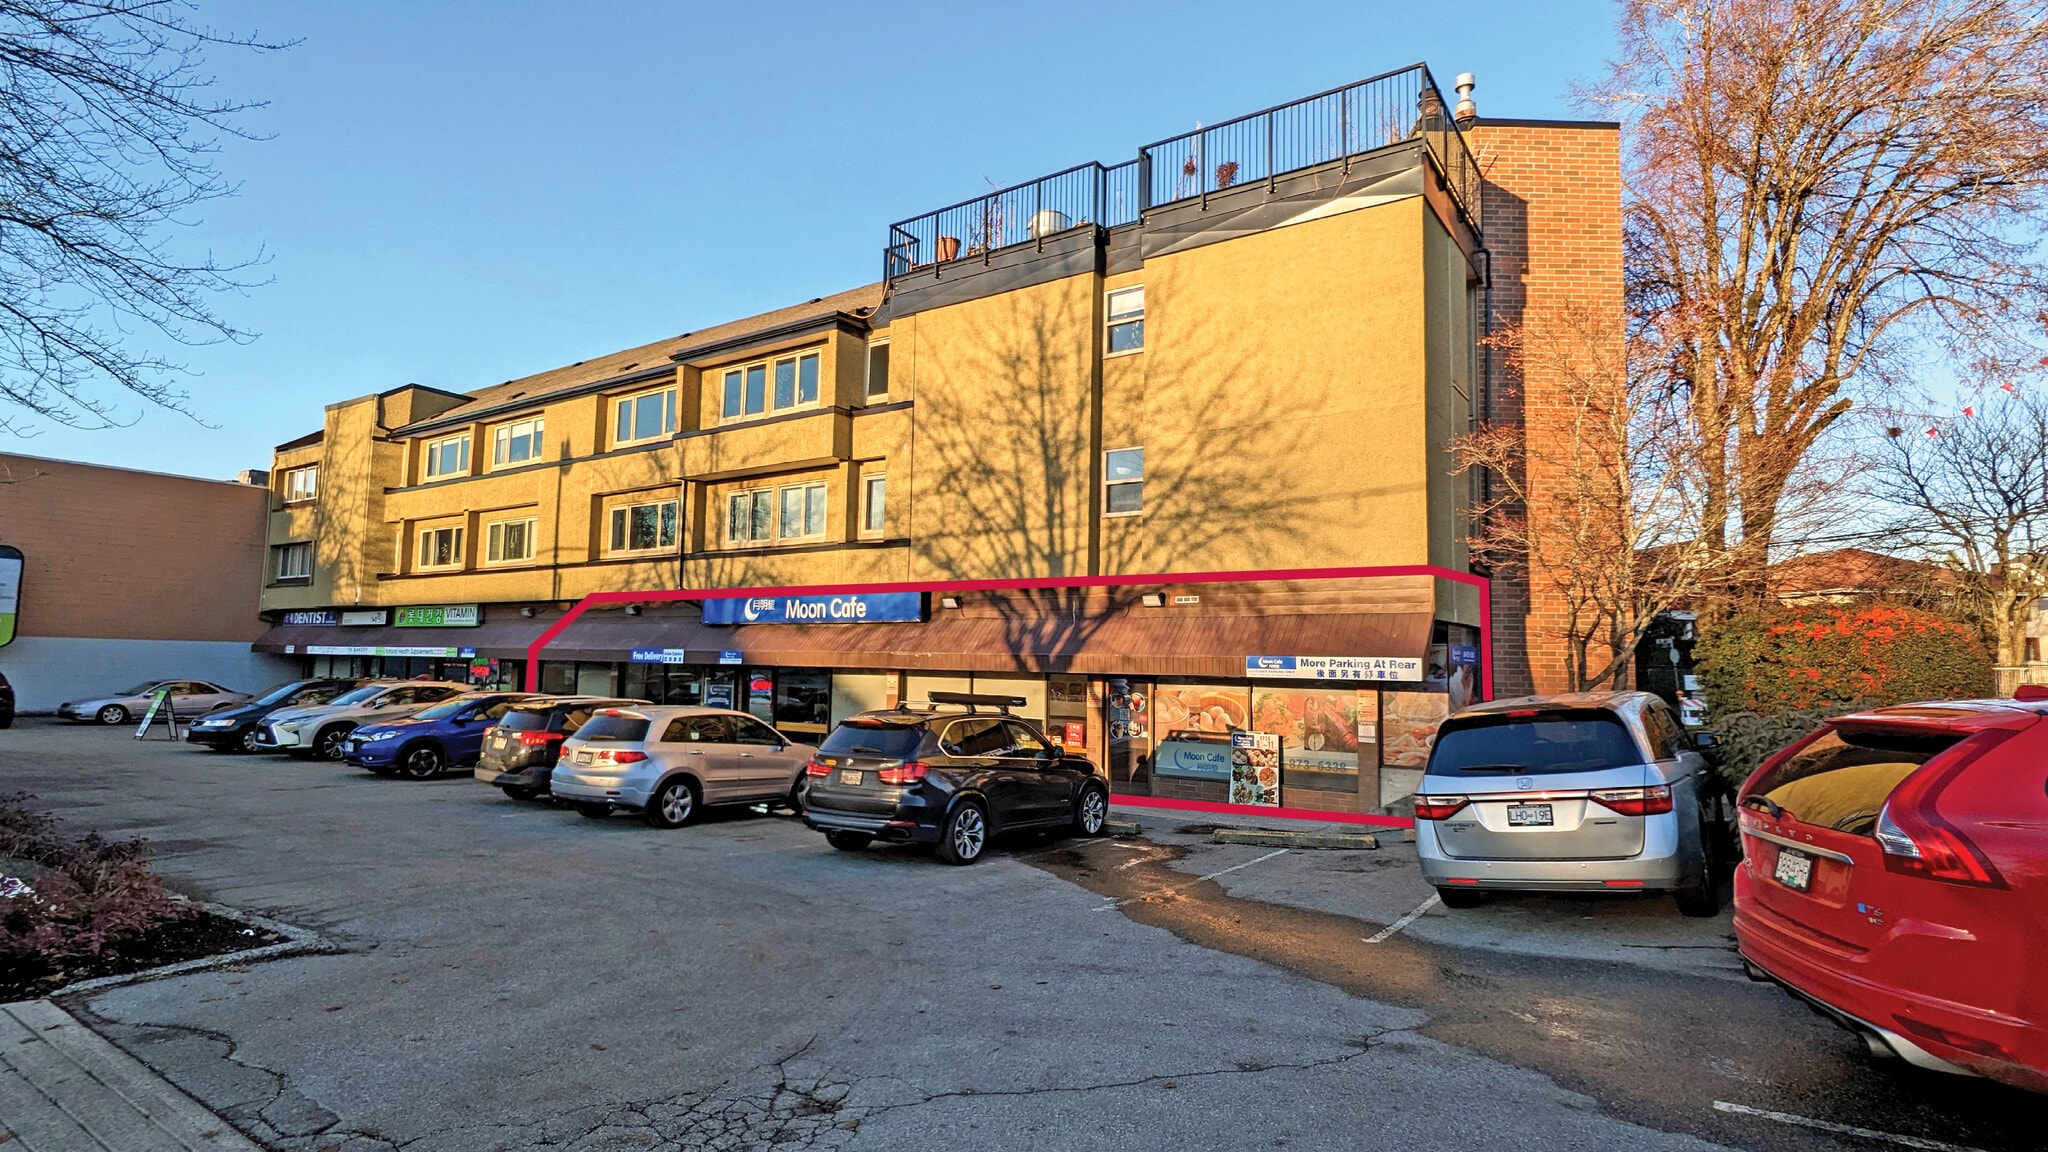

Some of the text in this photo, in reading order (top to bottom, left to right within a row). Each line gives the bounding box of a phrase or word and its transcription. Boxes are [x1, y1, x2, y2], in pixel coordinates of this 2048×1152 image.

[446, 607, 475, 618] VITAMIN
[785, 596, 867, 619] Moon Cafe
[294, 611, 327, 624] DENTIST
[633, 651, 644, 660] Free
[645, 651, 663, 662] Delivery
[1300, 658, 1416, 670] More Parking At Rear
[1184, 752, 1225, 762] Moon Cafe
